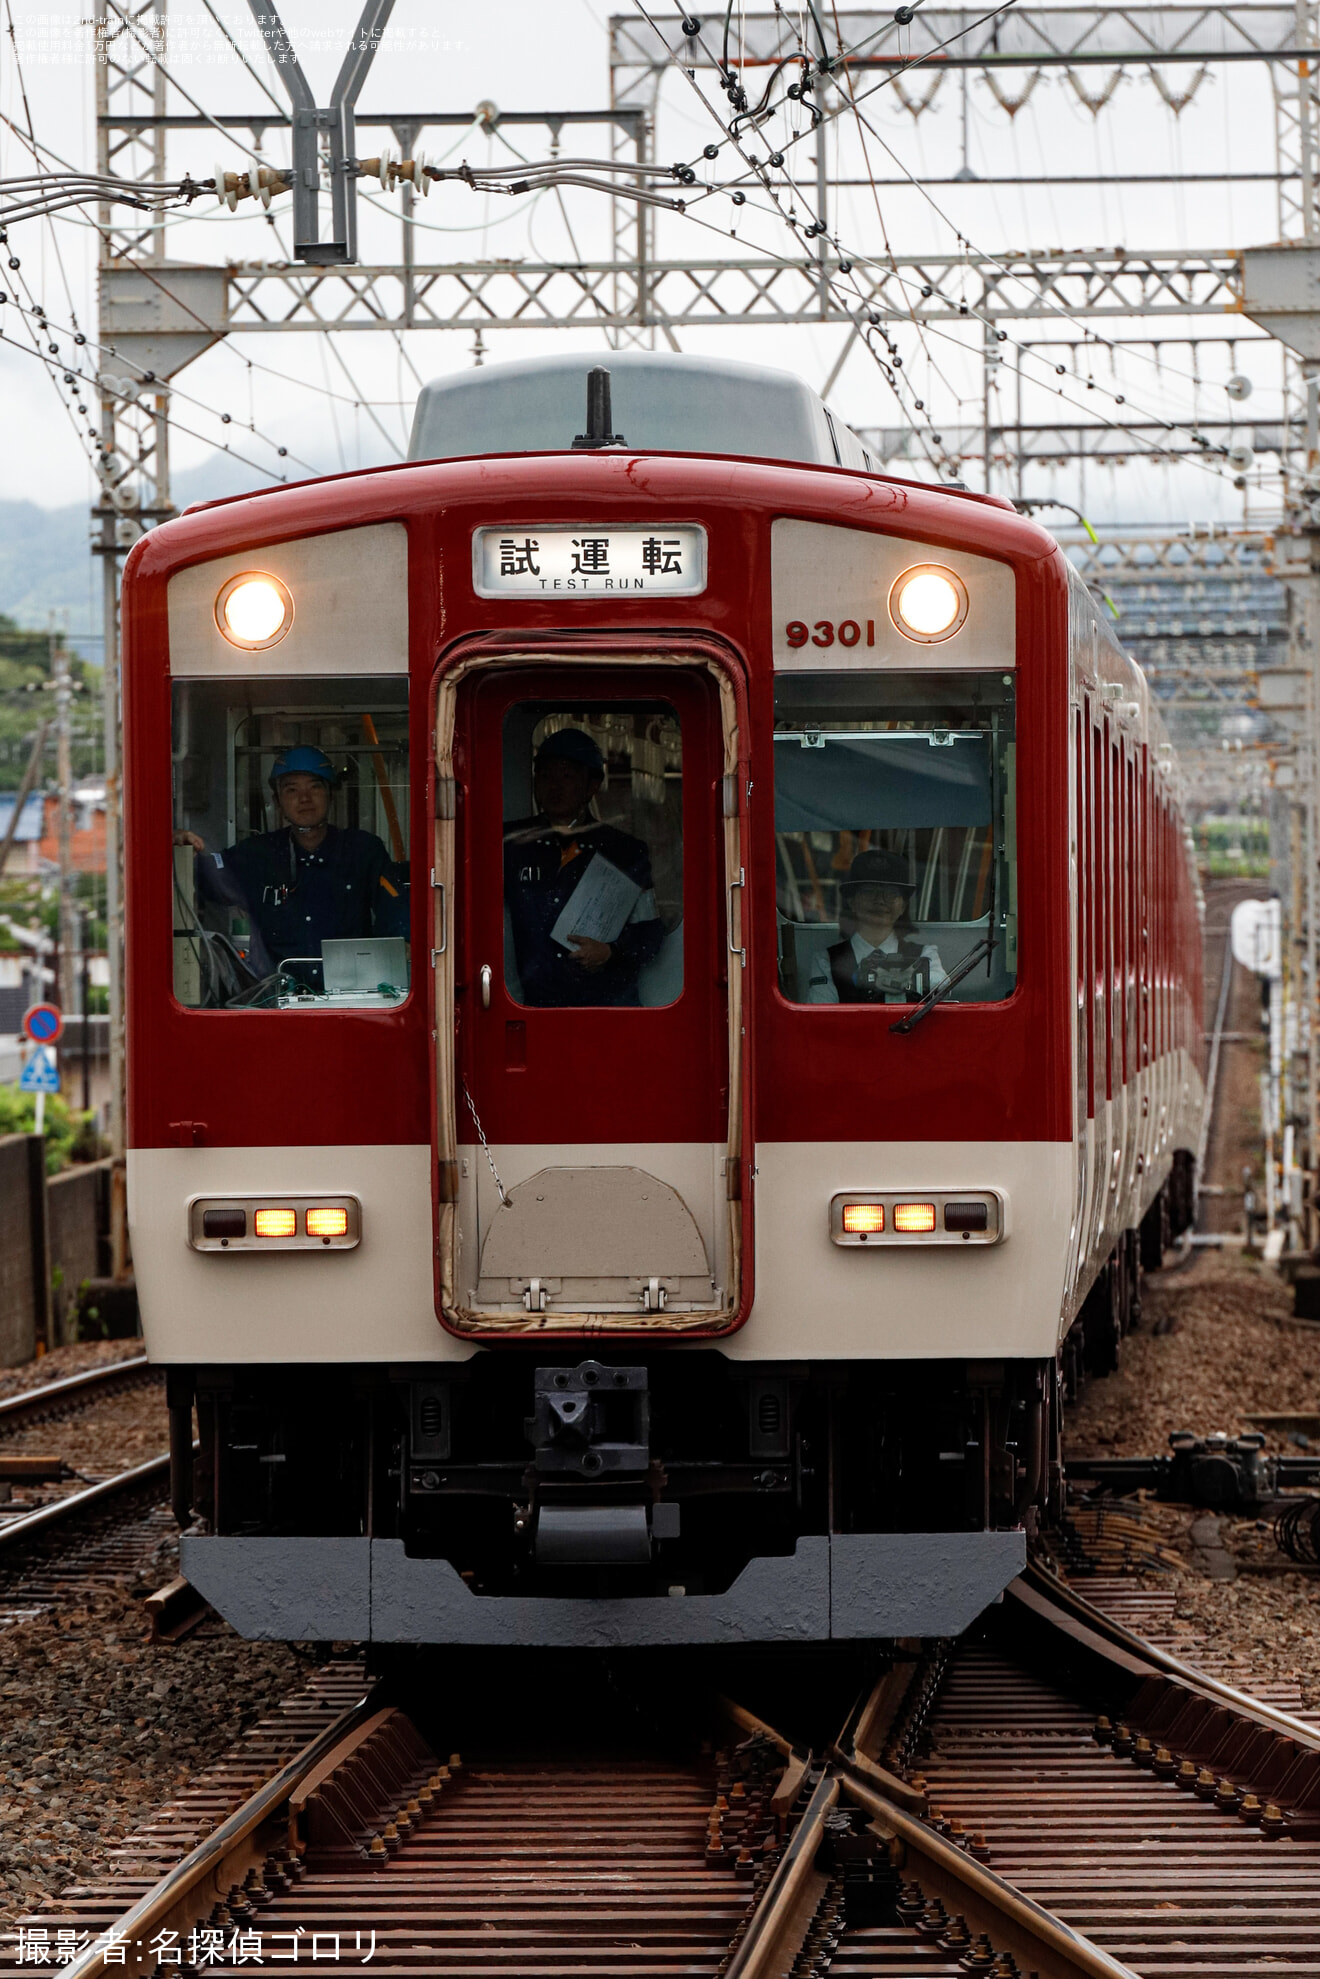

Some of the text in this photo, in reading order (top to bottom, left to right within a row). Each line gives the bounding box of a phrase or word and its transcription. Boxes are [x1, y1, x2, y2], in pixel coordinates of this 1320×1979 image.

[500, 538, 683, 576] 試運転
[539, 577, 645, 590] TEST RUN
[786, 619, 876, 648] 9301
